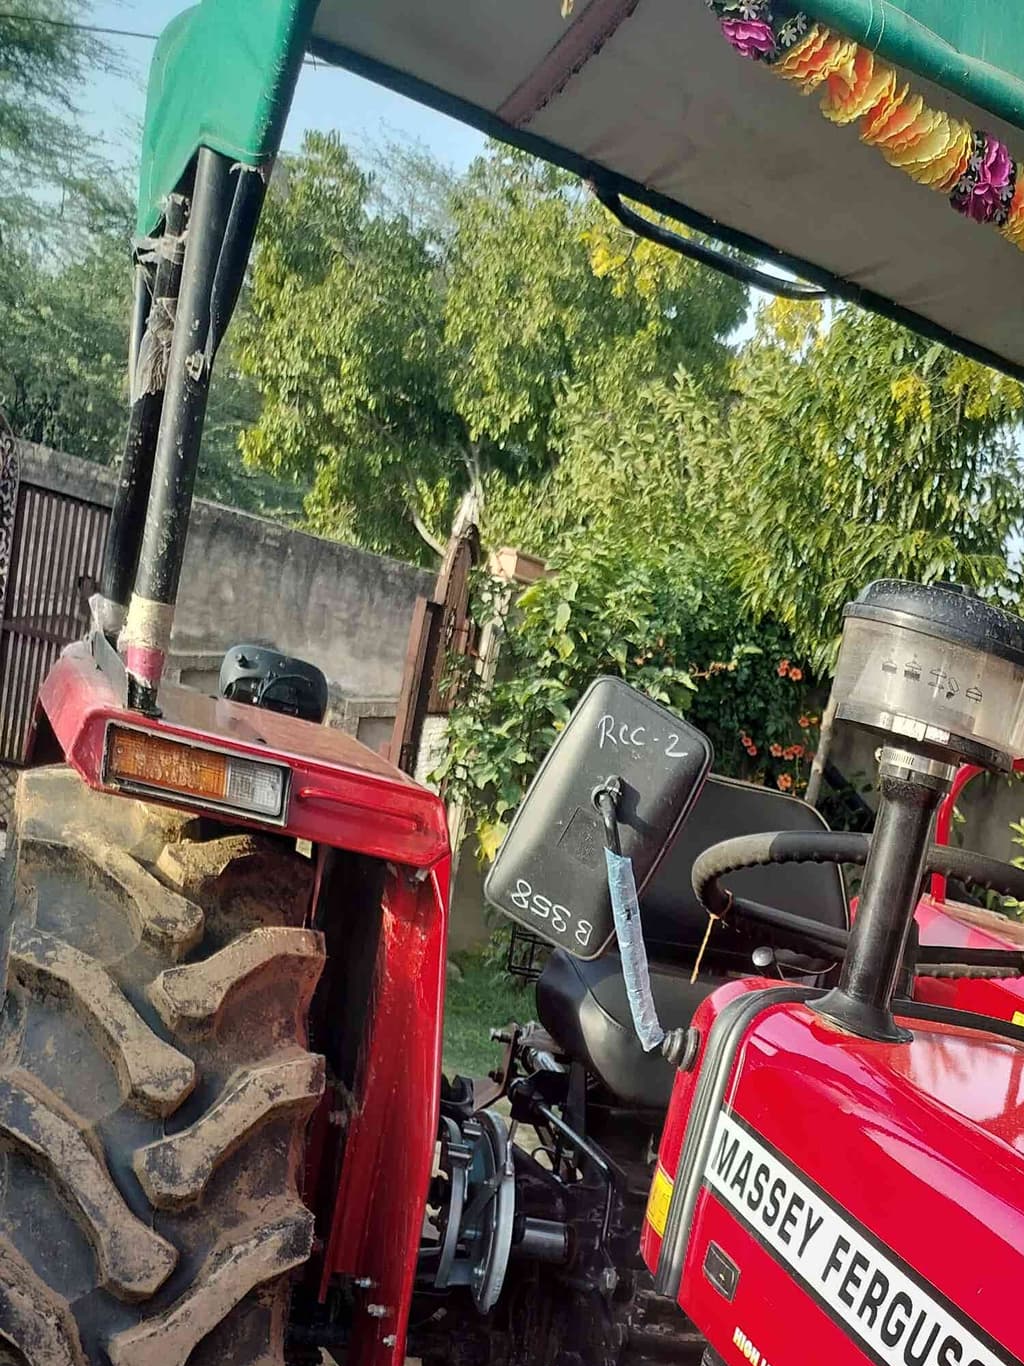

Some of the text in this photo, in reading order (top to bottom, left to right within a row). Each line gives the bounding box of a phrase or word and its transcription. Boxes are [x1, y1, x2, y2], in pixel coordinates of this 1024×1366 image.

[511, 879, 593, 946] B 358
[711, 1128, 824, 1258] MASSEY
[733, 1327, 760, 1366] HIGH
